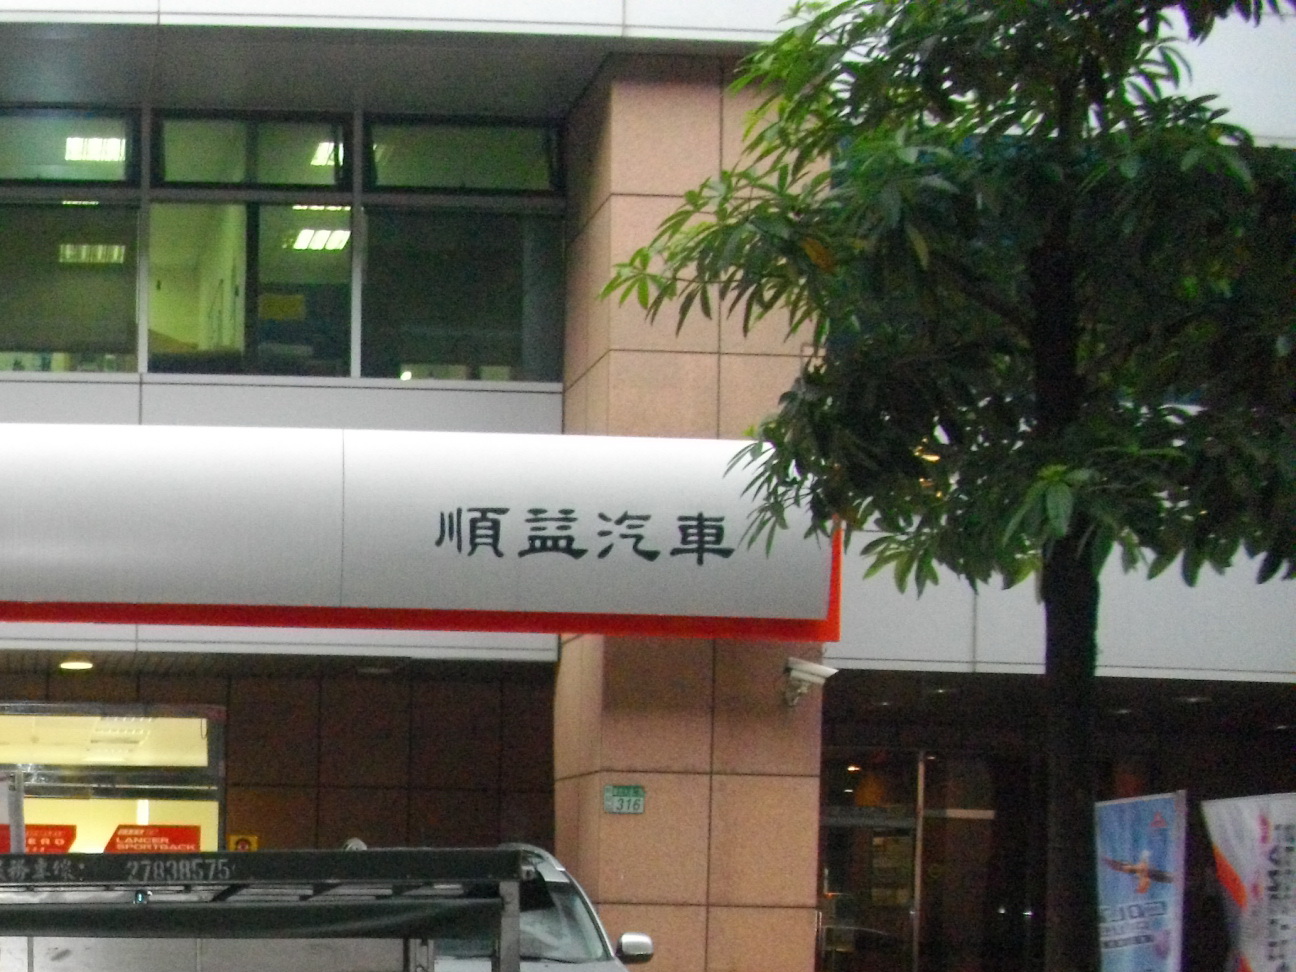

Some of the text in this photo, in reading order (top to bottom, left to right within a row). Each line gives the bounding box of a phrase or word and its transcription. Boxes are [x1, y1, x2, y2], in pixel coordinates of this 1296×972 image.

[434, 506, 735, 566] 順益汽車
[615, 798, 641, 811] 316
[115, 836, 170, 844] LANCER
[125, 857, 231, 883] 27838575
